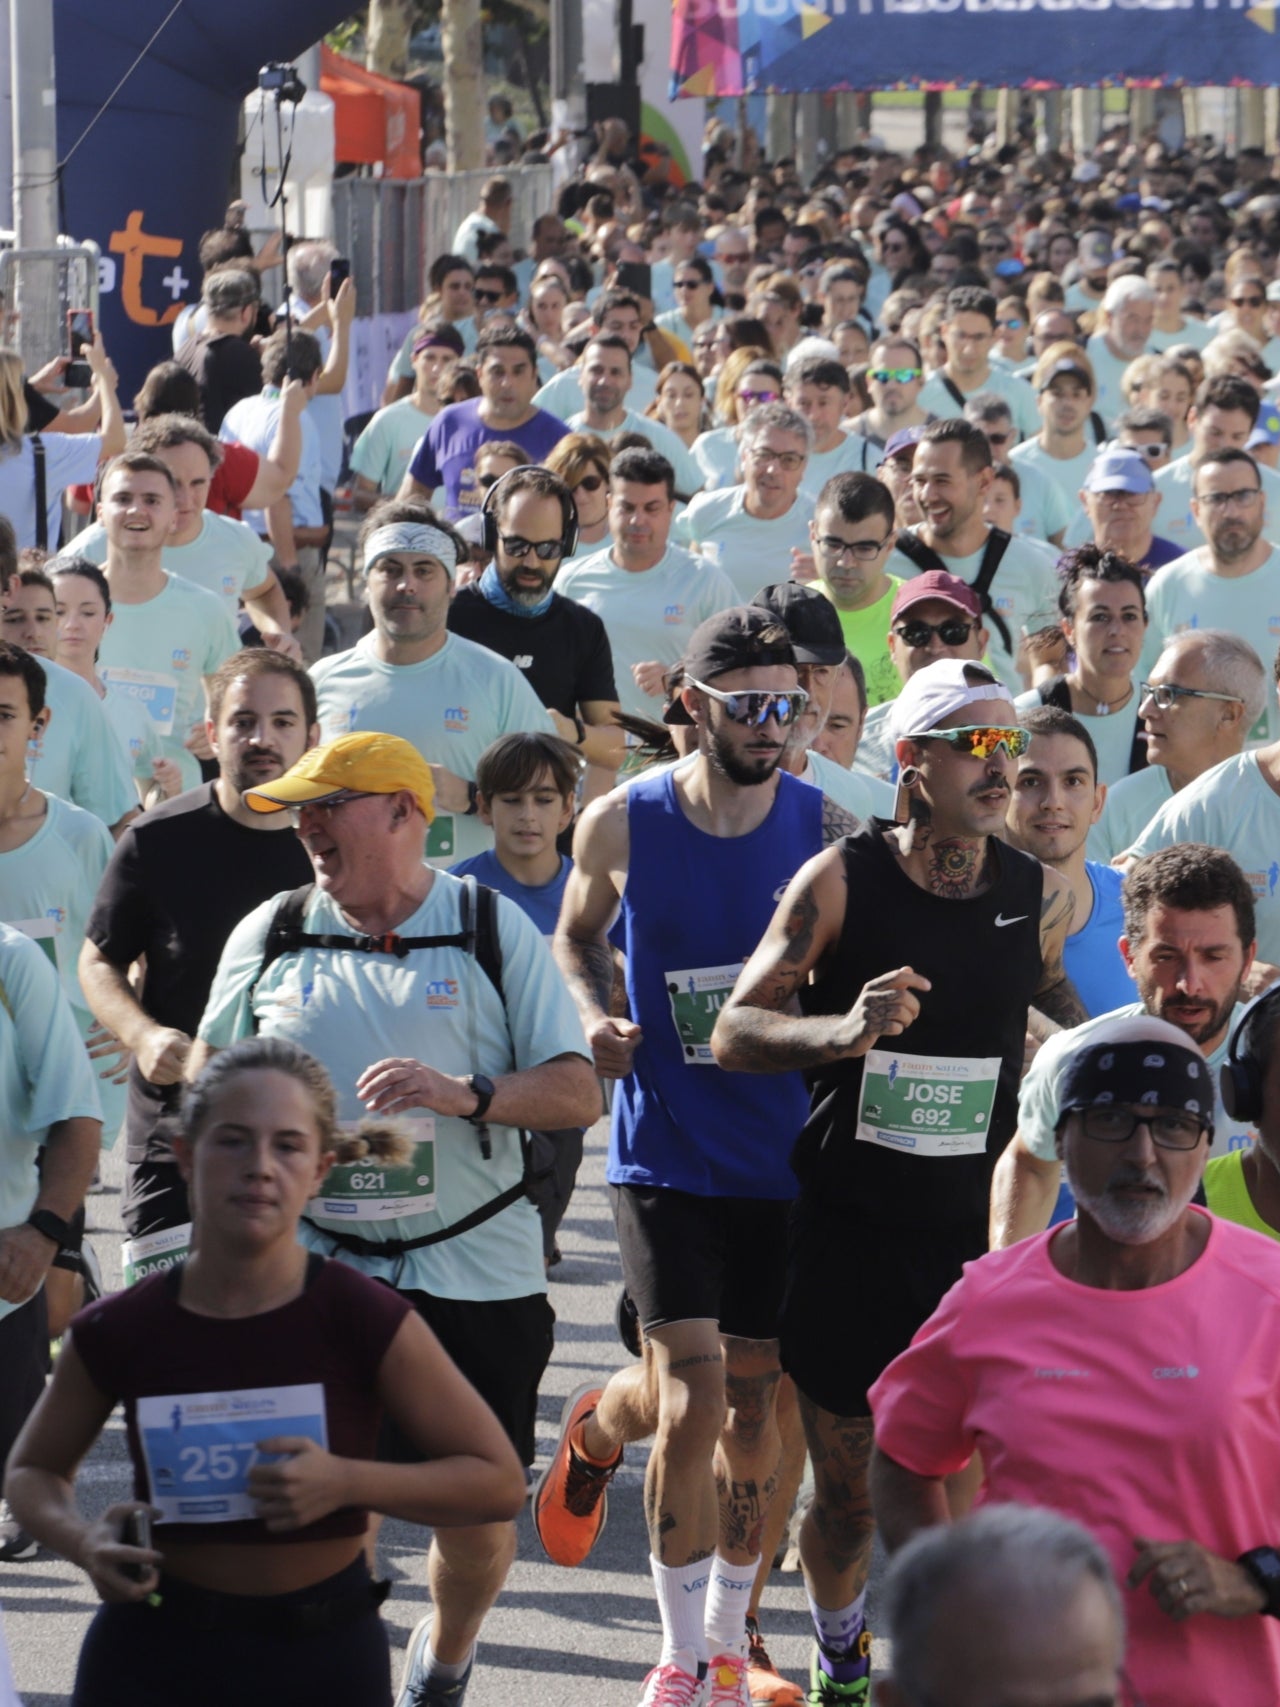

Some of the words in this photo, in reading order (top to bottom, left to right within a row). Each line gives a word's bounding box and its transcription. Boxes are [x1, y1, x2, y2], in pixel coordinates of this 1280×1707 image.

[904, 1082, 964, 1104] JOSE
[911, 1108, 952, 1126] 692
[350, 1173, 386, 1190] 621
[1152, 1367, 1184, 1379] CIRSA
[178, 1442, 290, 1482] 257
